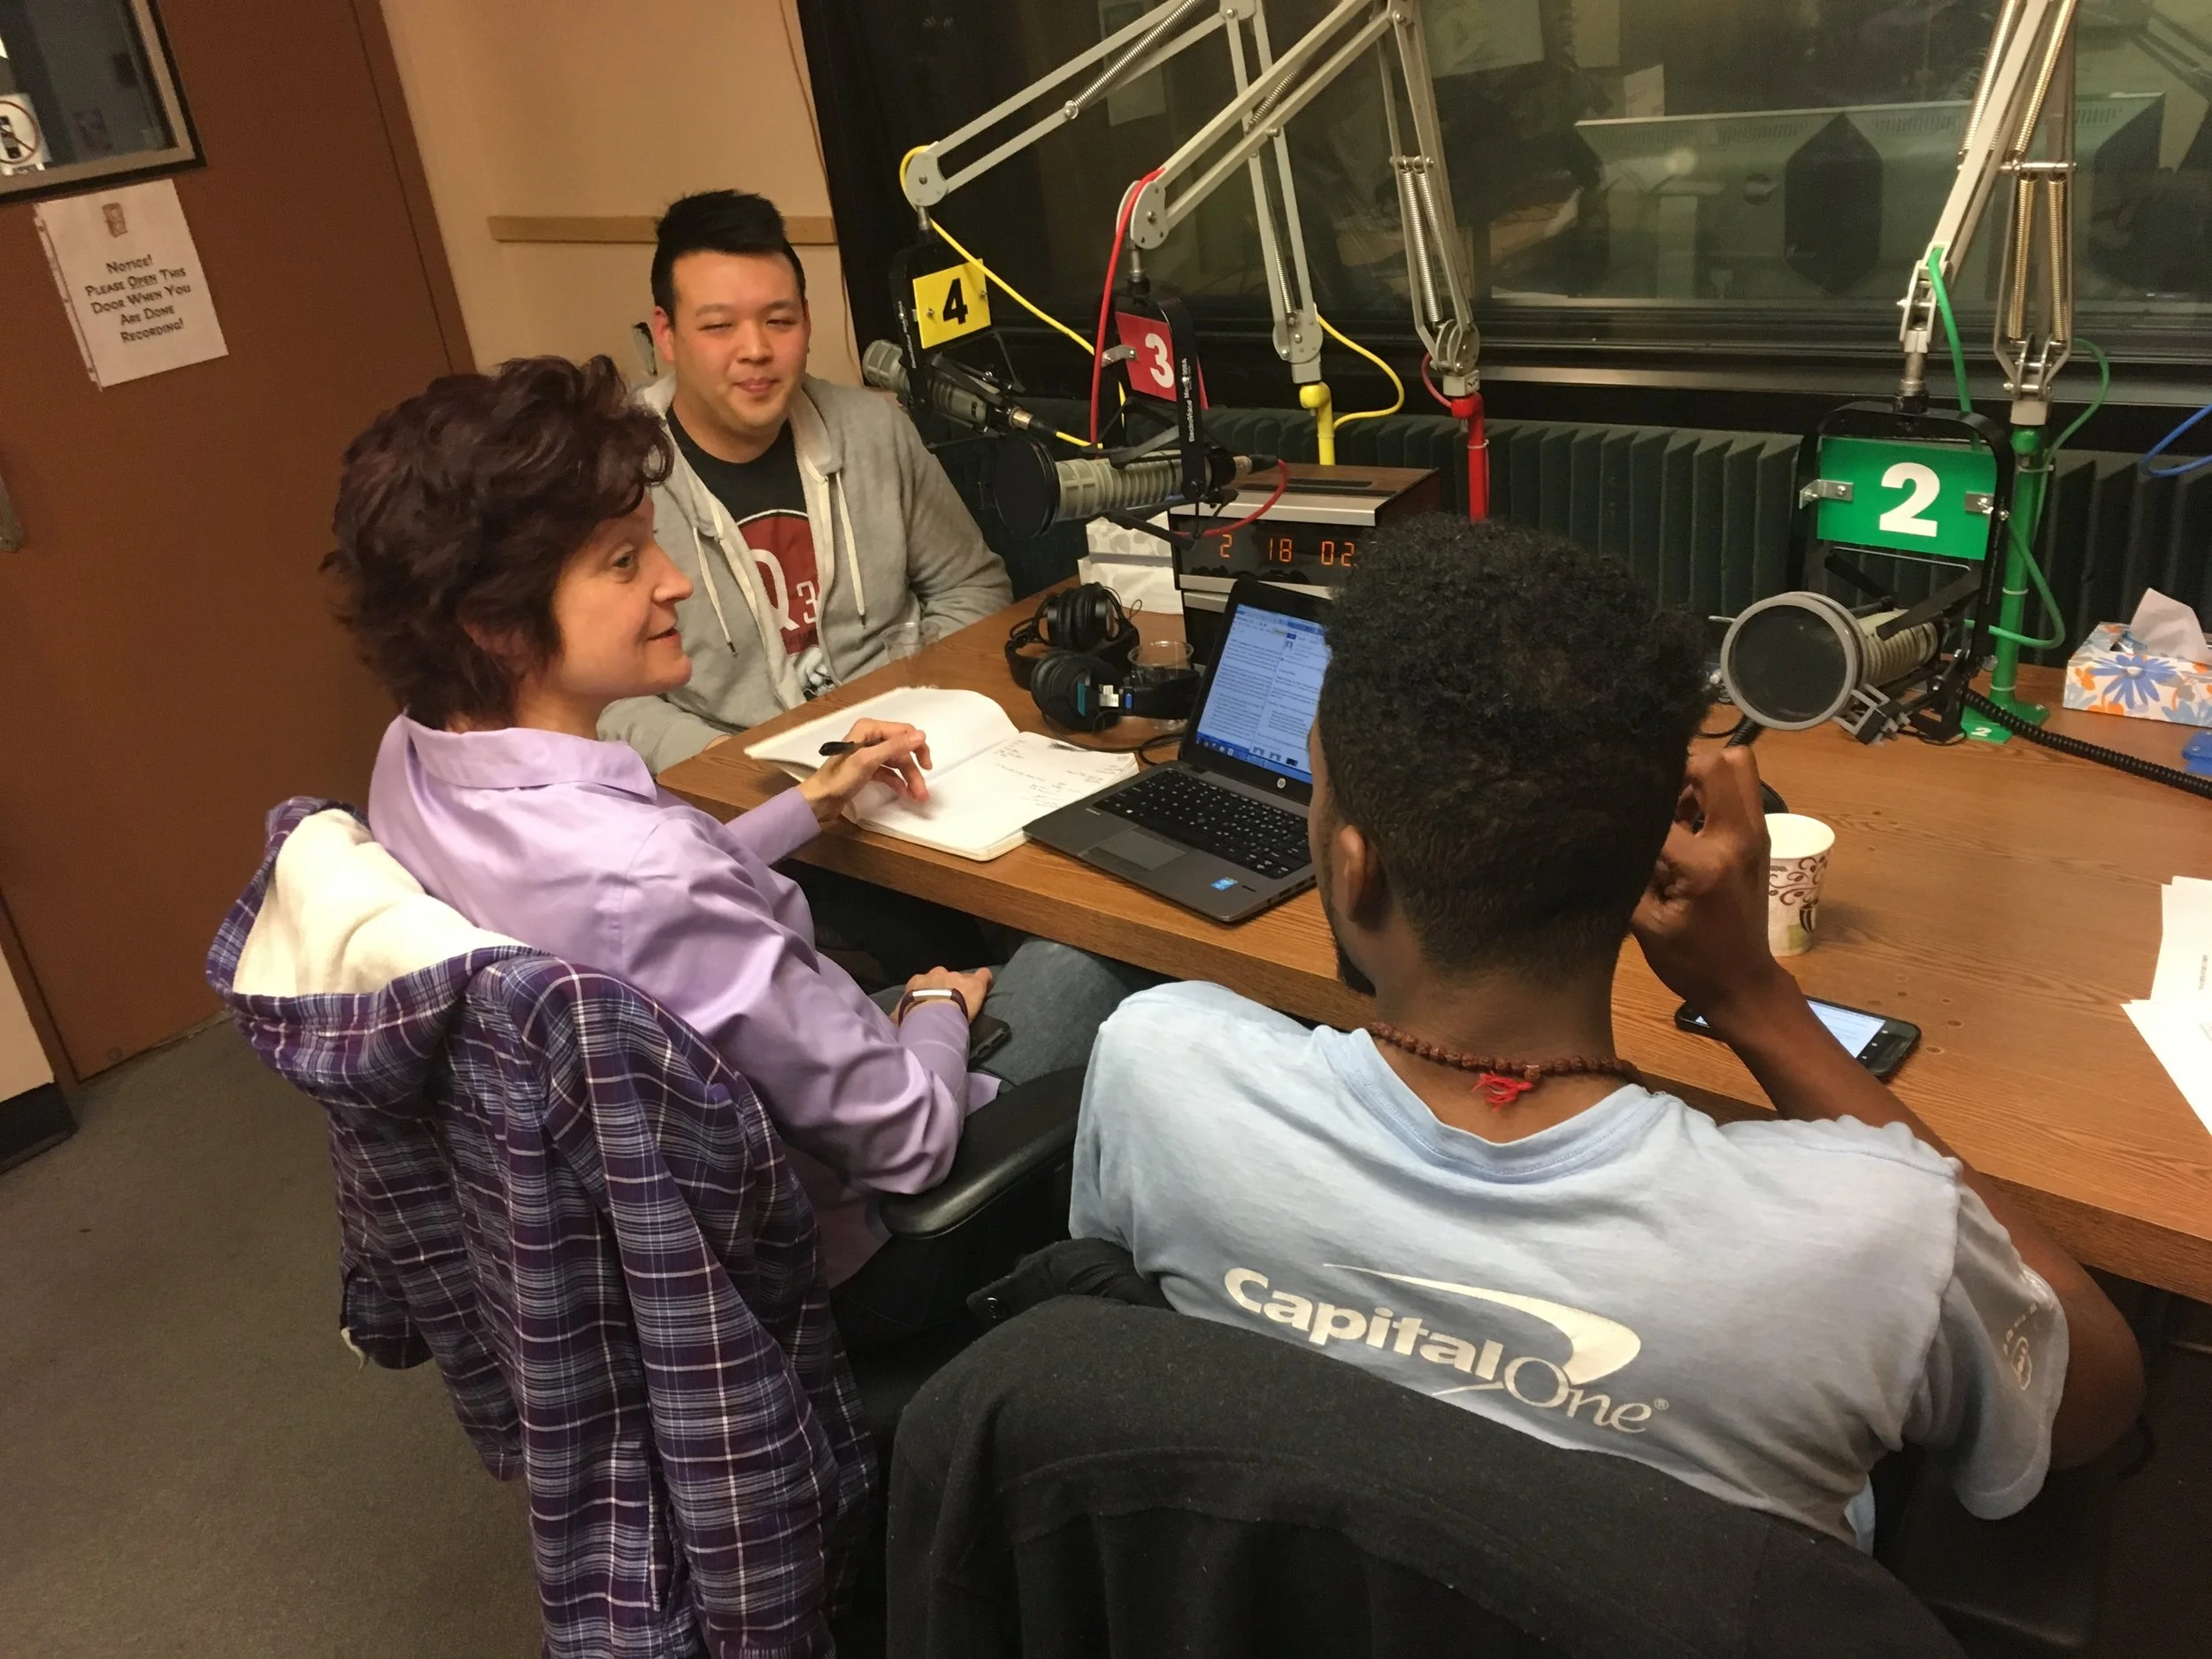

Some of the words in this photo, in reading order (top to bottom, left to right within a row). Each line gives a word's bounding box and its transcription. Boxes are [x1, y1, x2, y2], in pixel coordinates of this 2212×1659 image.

[85, 281, 125, 296] PLEASE
[127, 274, 157, 289] OPEN
[90, 300, 125, 314] DOOR
[127, 291, 163, 304] WHEN
[164, 285, 191, 296] YOU
[121, 313, 142, 326] ARE
[143, 305, 175, 319] DONE
[942, 278, 969, 325] 4
[1145, 333, 1174, 388] 3
[1879, 462, 1940, 537] 2
[1219, 534, 1233, 557] 2
[1269, 538, 1293, 563] 18
[1321, 541, 1356, 567] 02
[1970, 726, 1992, 737] 2
